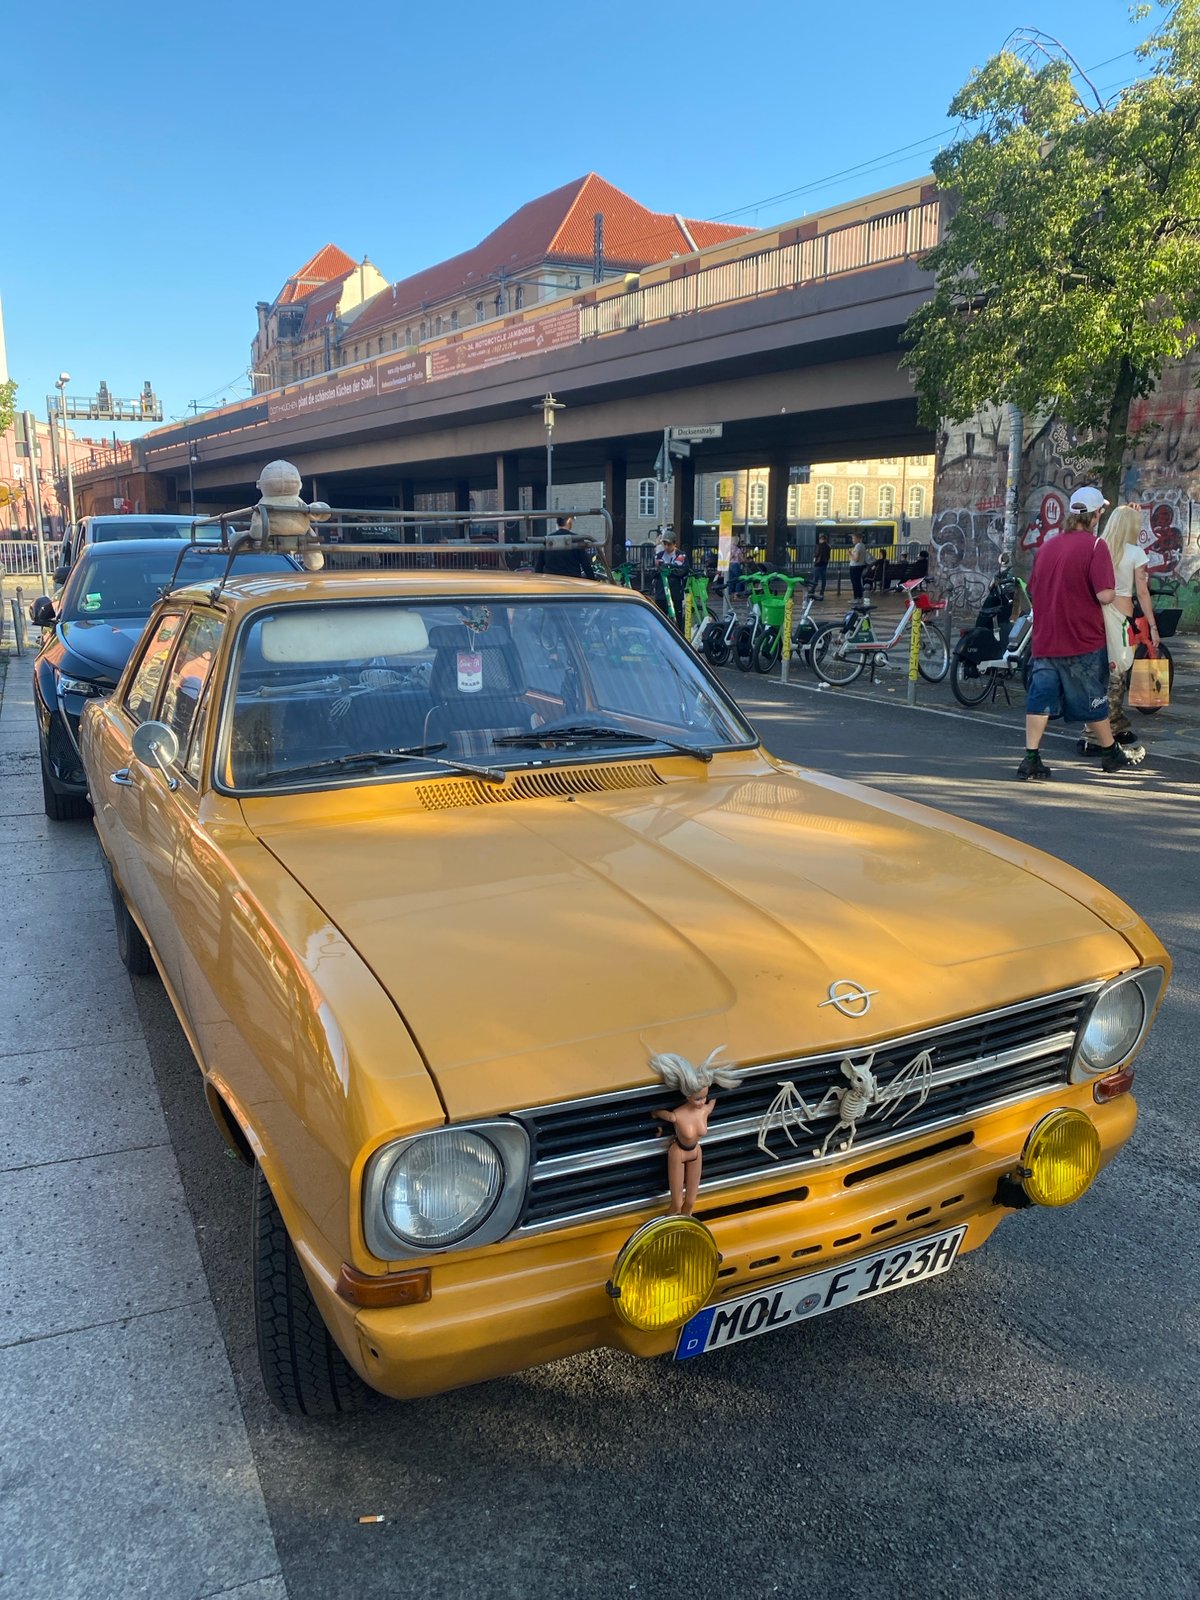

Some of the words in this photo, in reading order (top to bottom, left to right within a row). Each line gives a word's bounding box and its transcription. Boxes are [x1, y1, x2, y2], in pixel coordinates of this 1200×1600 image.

[475, 334, 506, 349] MOTORCYCLE
[507, 325, 536, 340] JAMBOREE
[298, 396, 308, 410] plant
[315, 388, 336, 403] schönsten
[336, 383, 352, 397] Küchen
[352, 380, 361, 392] der
[708, 1291, 792, 1346] MOL
[823, 1267, 857, 1308] F
[857, 1233, 961, 1297] 123H
[686, 1338, 698, 1350] D
